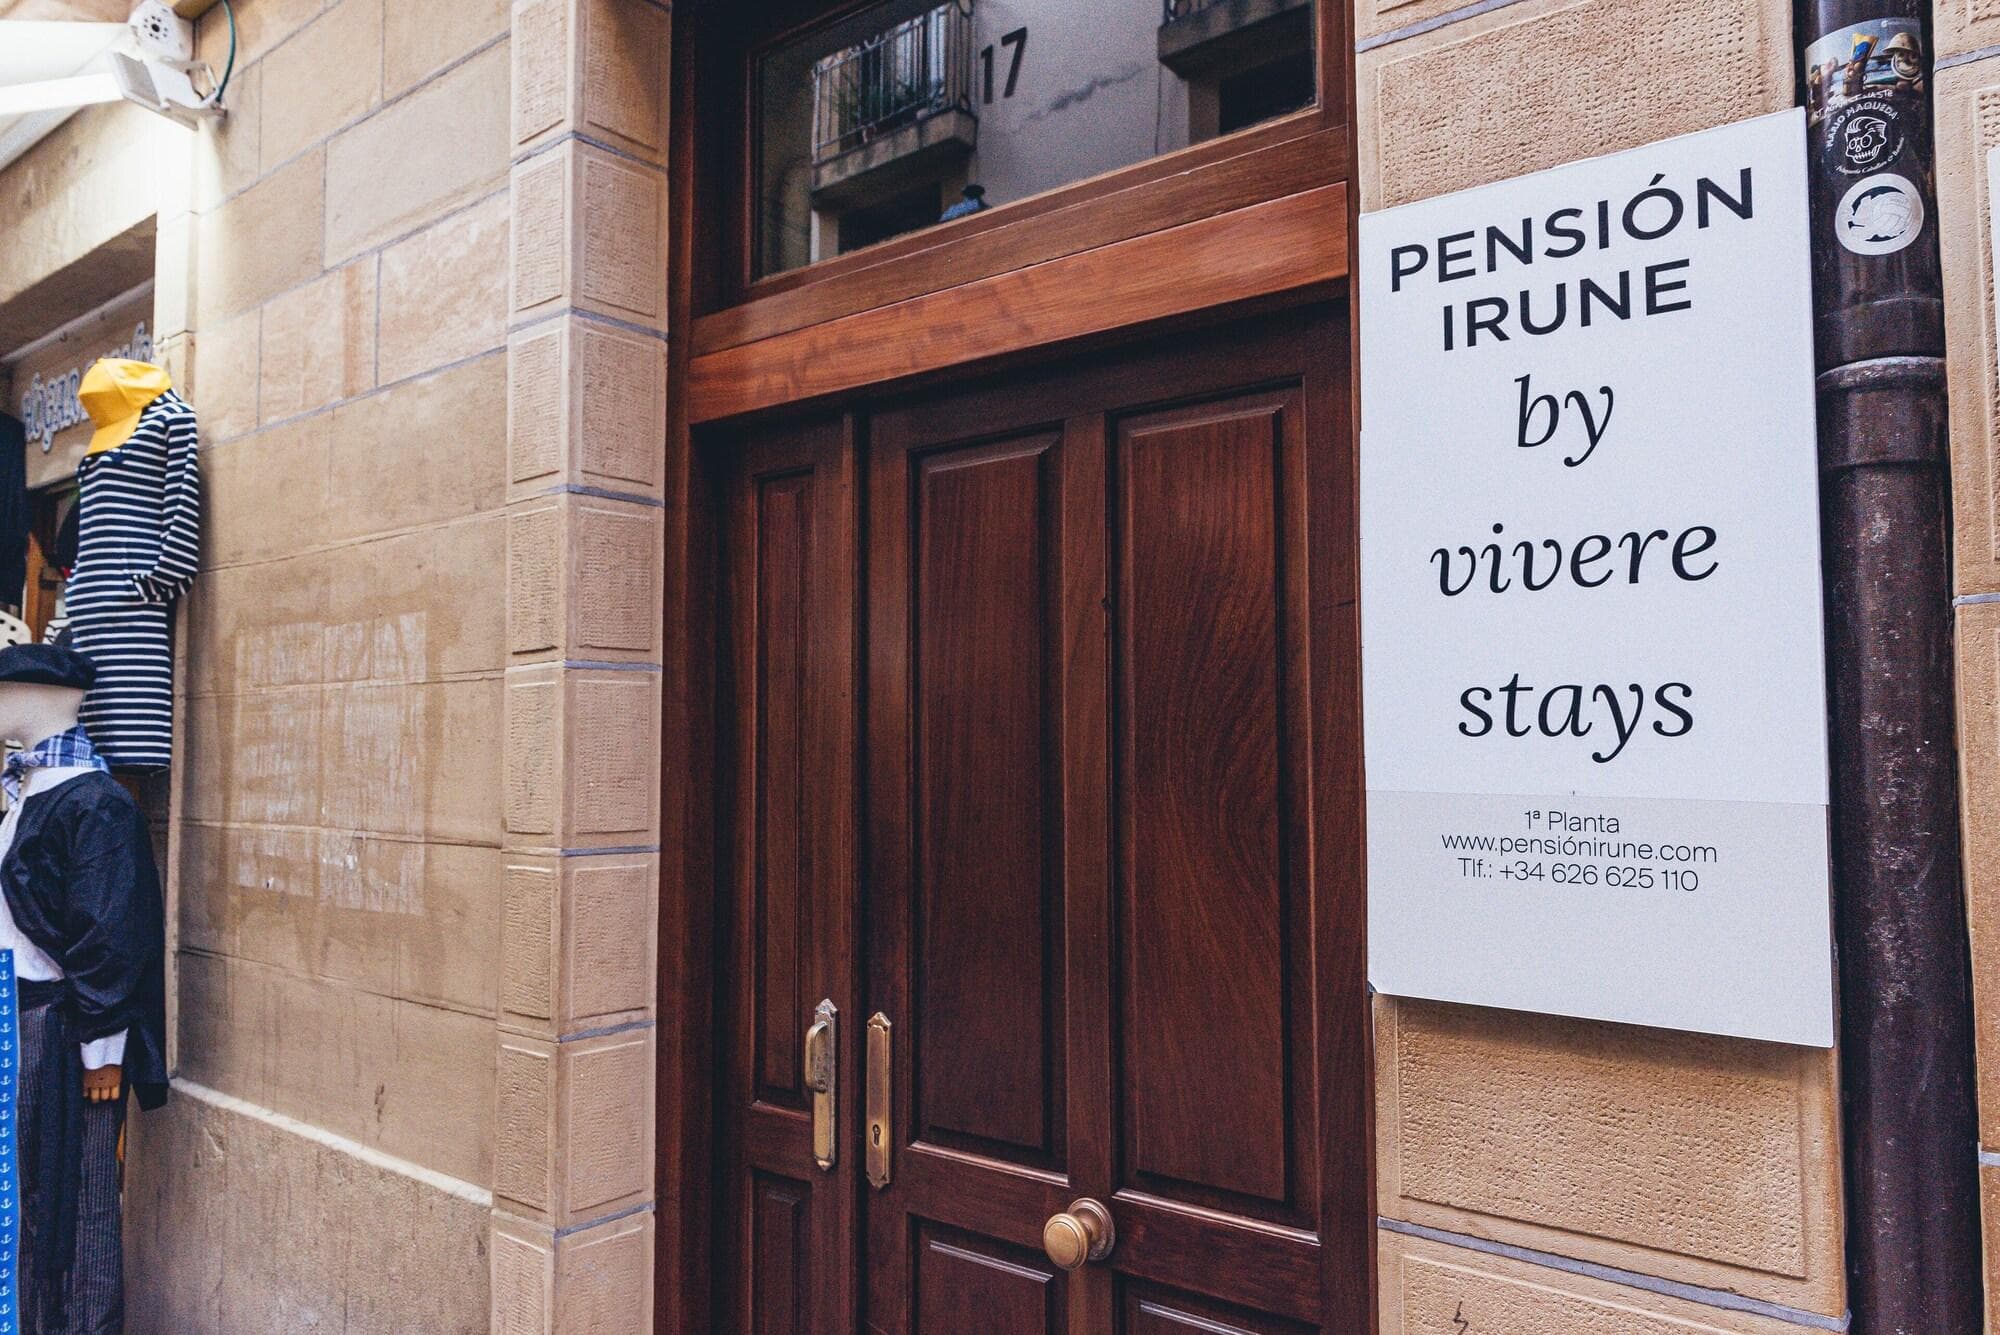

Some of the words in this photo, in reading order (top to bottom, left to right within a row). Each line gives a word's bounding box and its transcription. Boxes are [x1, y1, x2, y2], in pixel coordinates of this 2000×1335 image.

[980, 26, 1027, 104] 17
[1391, 167, 1753, 293] PENSIÓN
[1443, 258, 1692, 352] IRUNE
[1514, 373, 1614, 468] by
[1429, 522, 1720, 597] vivere
[1458, 673, 1694, 764] stays
[1441, 834, 1718, 864] www.pensiónirune.com
[1548, 810, 1620, 834] Planta
[1456, 857, 1492, 879] Tlf.:
[1499, 860, 1546, 882] +34
[1551, 862, 1599, 886] 626
[1605, 865, 1655, 889] 625
[1660, 868, 1699, 892] 110
